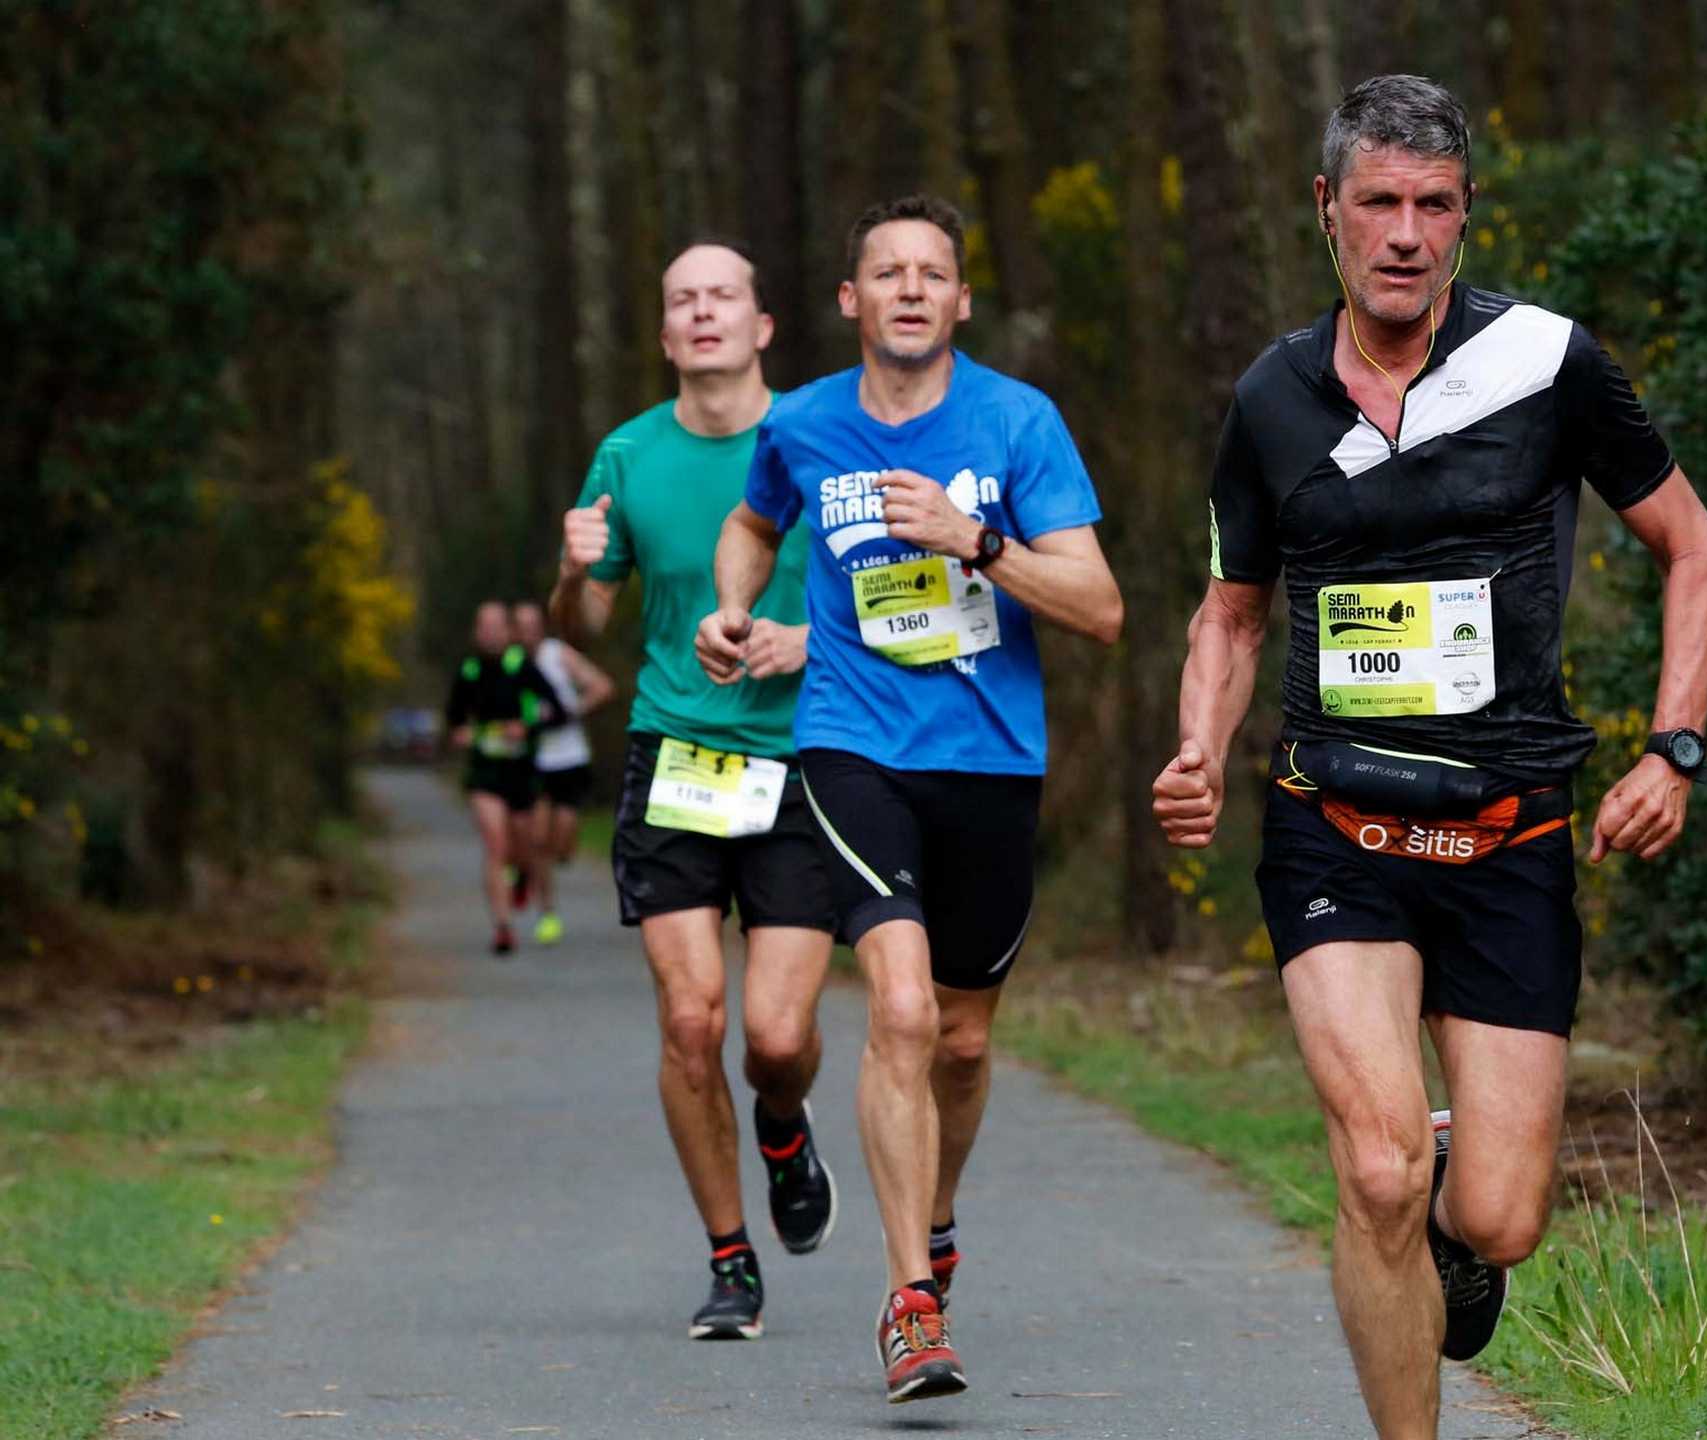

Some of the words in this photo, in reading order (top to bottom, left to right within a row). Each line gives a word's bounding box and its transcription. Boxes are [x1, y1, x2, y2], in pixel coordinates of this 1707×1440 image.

[862, 572, 890, 585] SEMI
[1328, 593, 1360, 606] SEMI
[1438, 592, 1474, 602] SUPER
[886, 613, 929, 635] 1360
[1348, 652, 1400, 674] 1000
